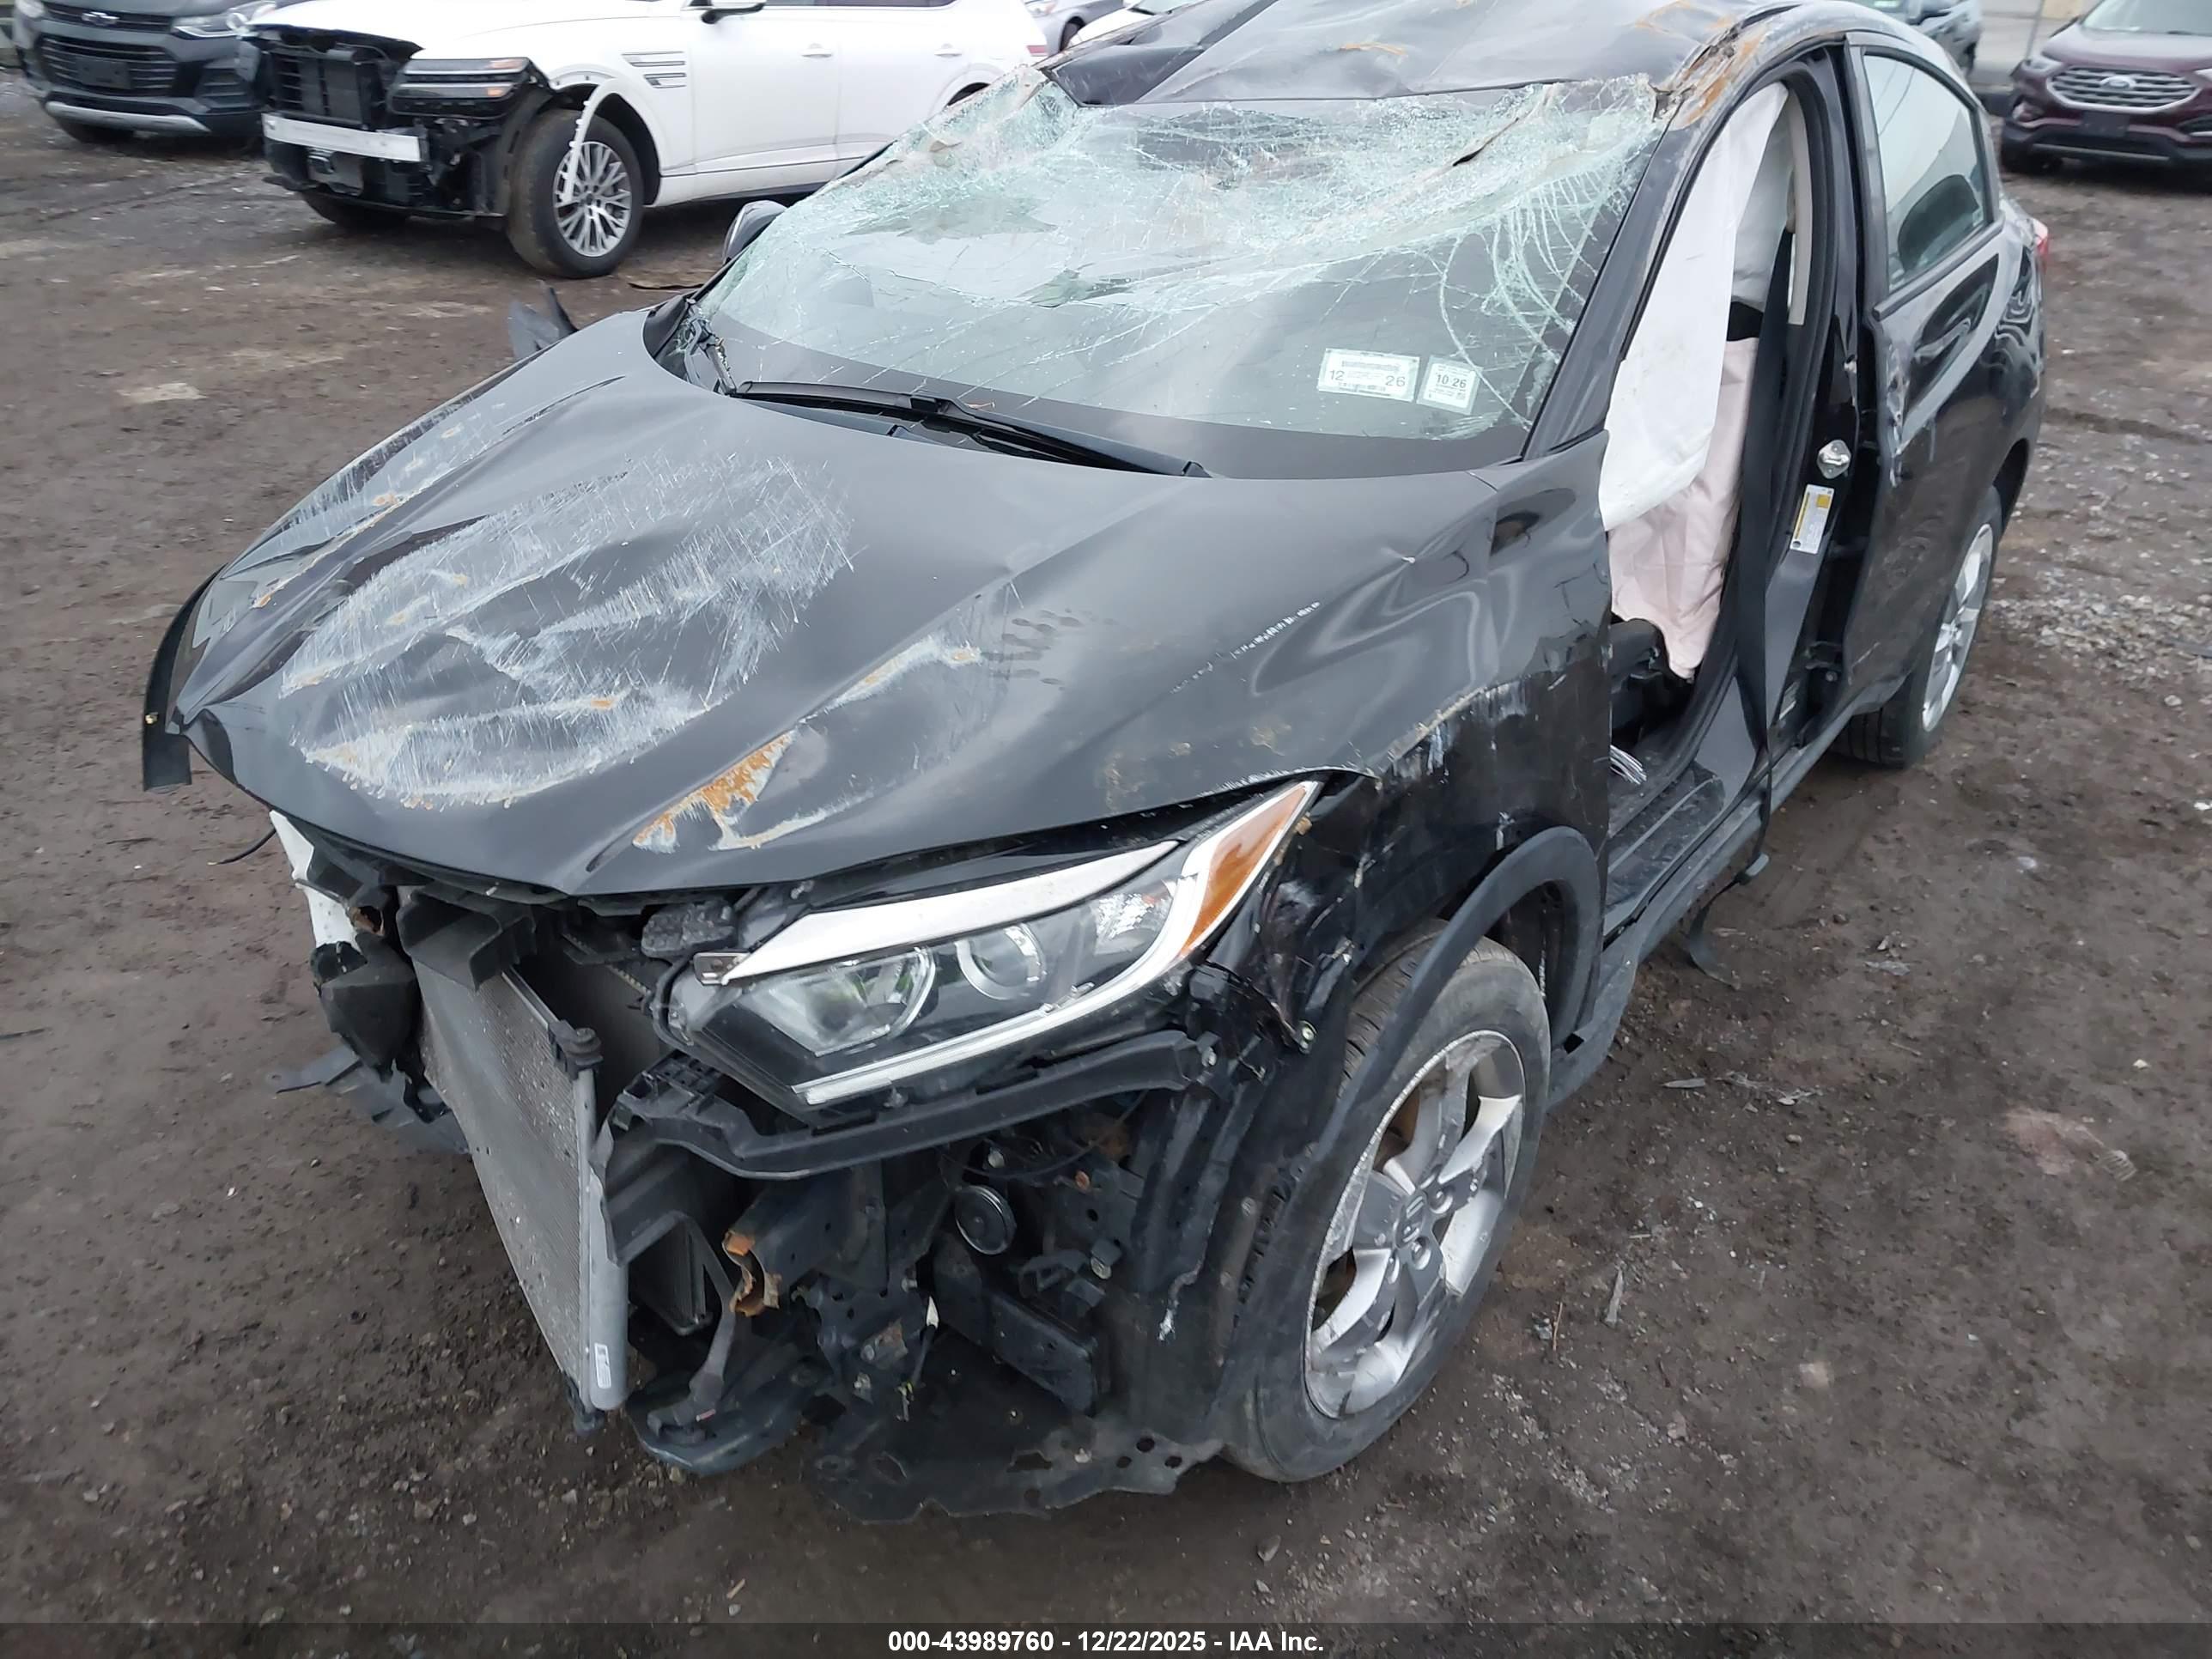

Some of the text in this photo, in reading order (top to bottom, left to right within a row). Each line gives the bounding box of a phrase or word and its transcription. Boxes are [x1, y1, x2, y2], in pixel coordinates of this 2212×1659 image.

[1329, 369, 1345, 381] 12
[1385, 375, 1406, 387] 26
[1437, 374, 1468, 389] 10 26
